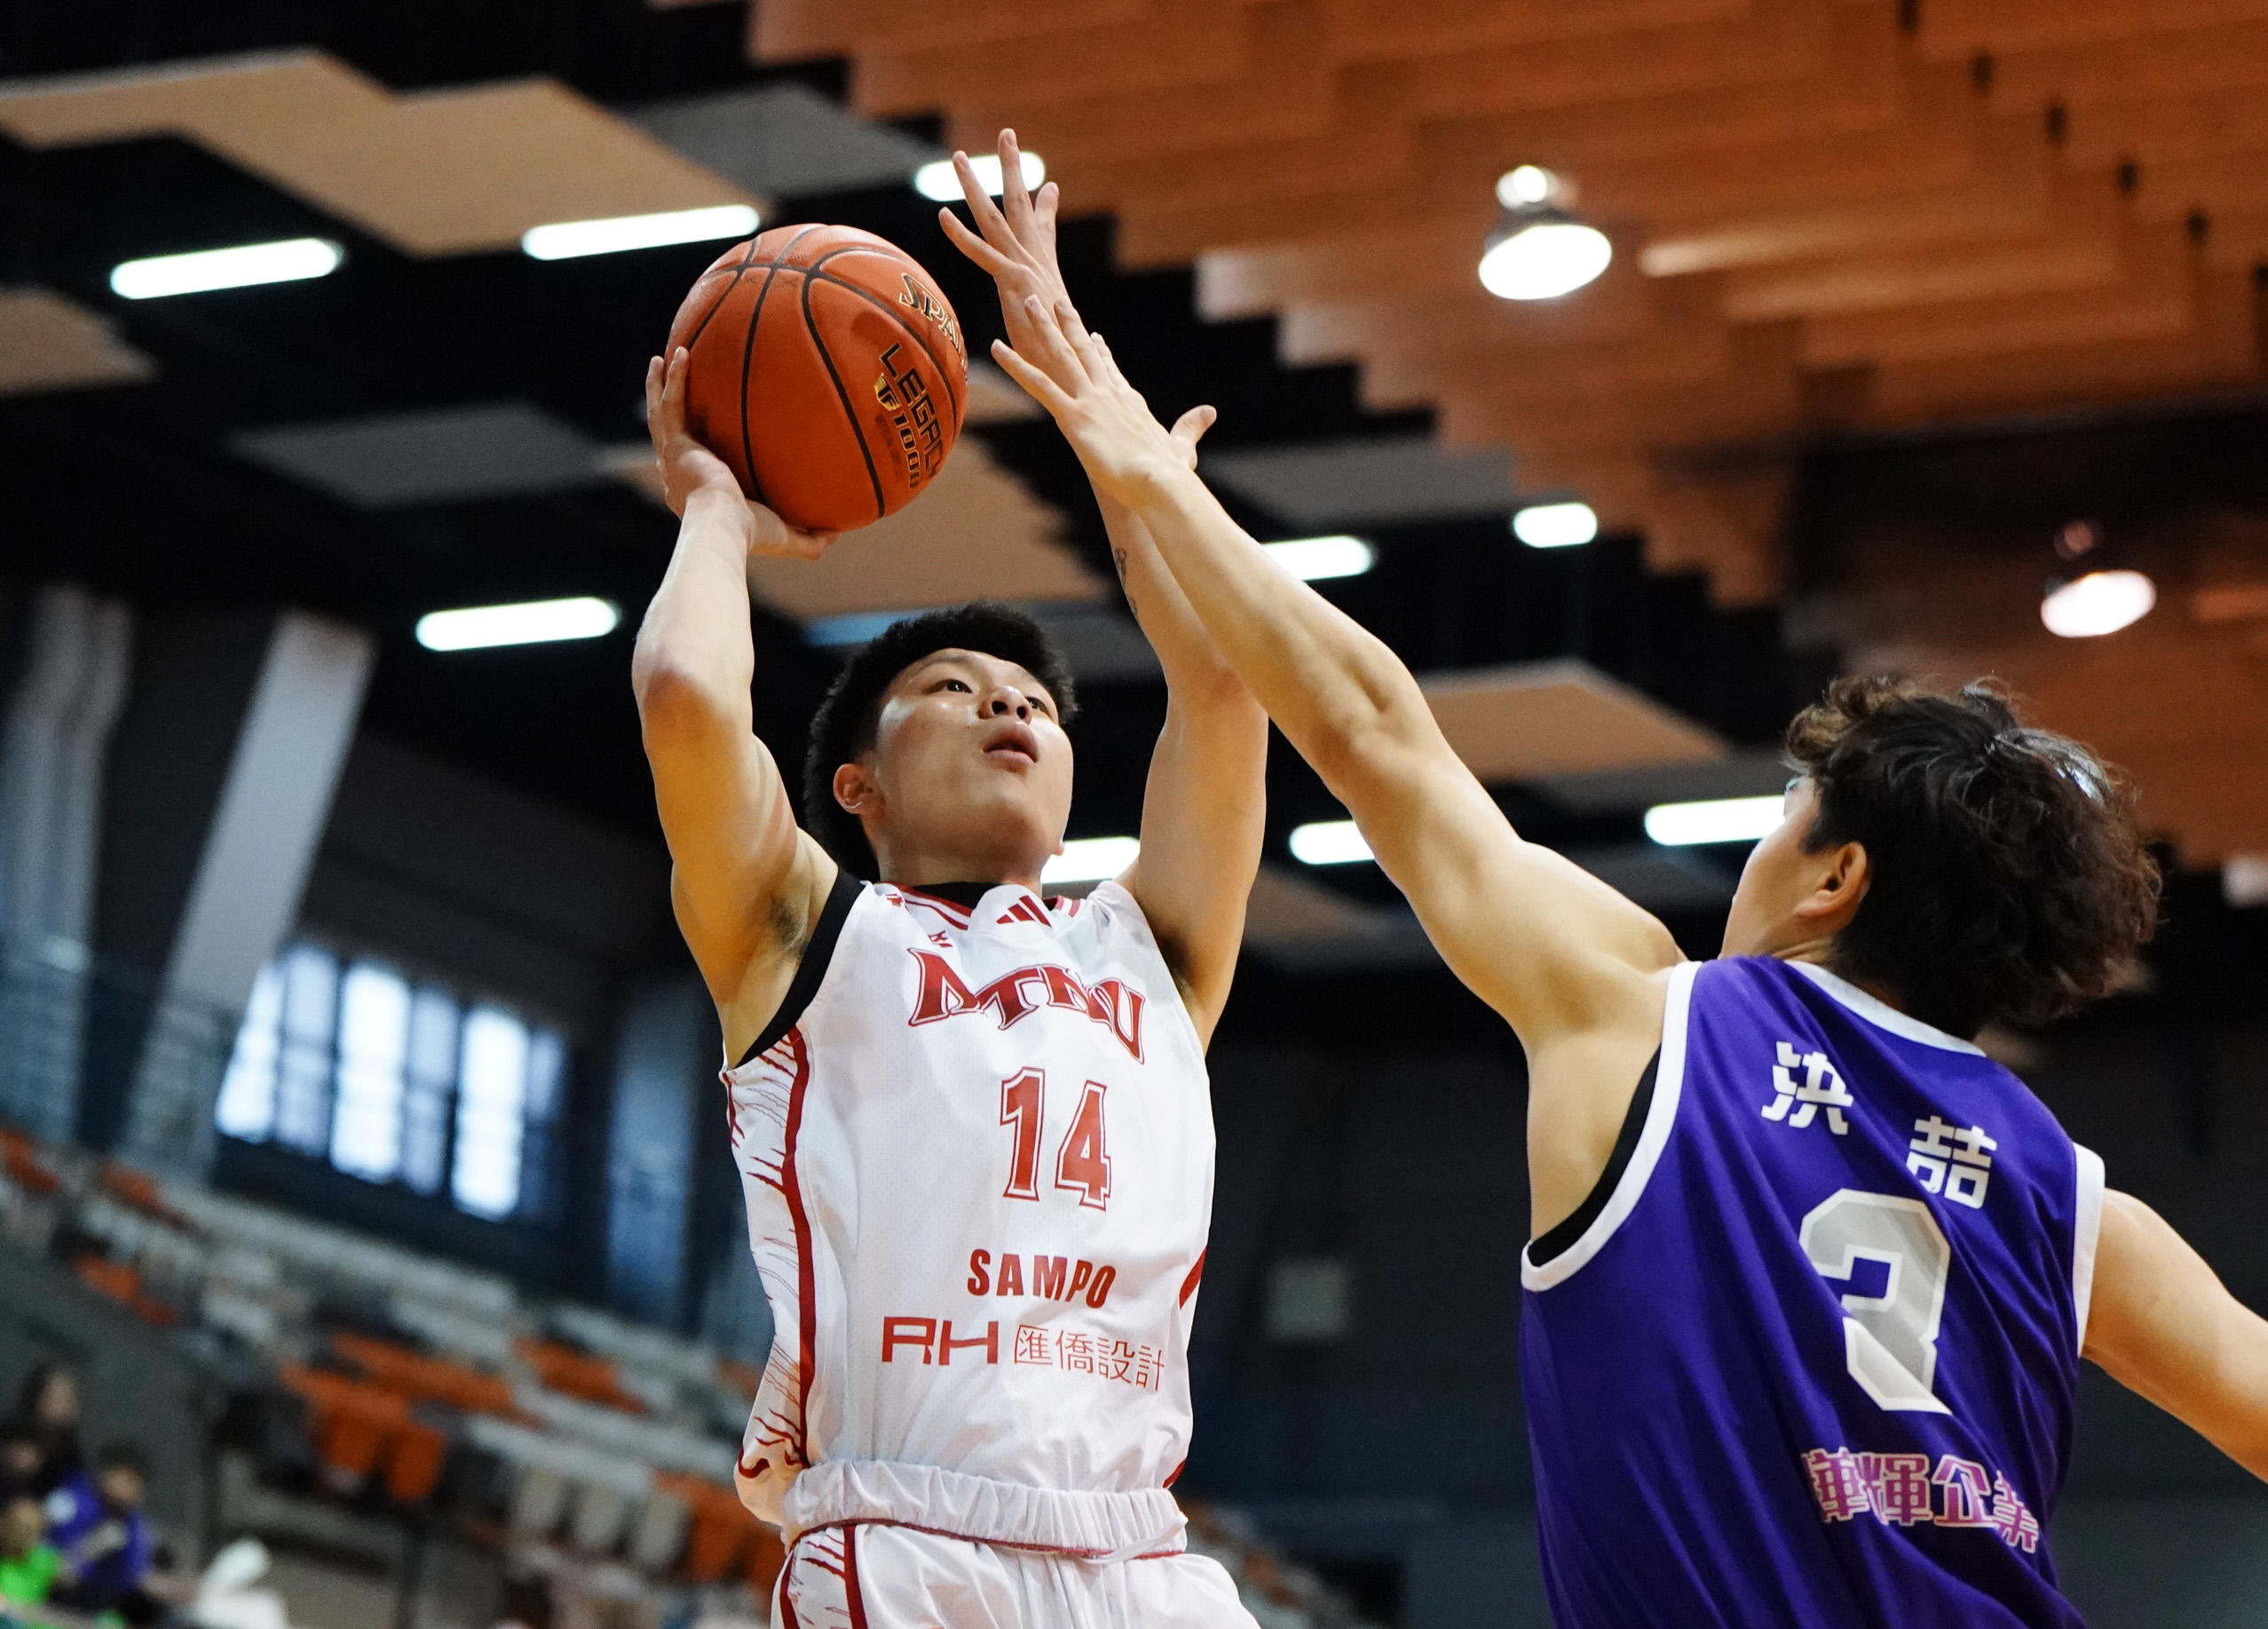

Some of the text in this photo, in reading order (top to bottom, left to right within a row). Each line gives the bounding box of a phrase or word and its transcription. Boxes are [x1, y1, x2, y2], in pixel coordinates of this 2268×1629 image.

[1000, 1066, 1111, 1212] 14
[968, 1249, 1116, 1309] SAMPO
[1014, 1325, 1165, 1391] 匯僑設計
